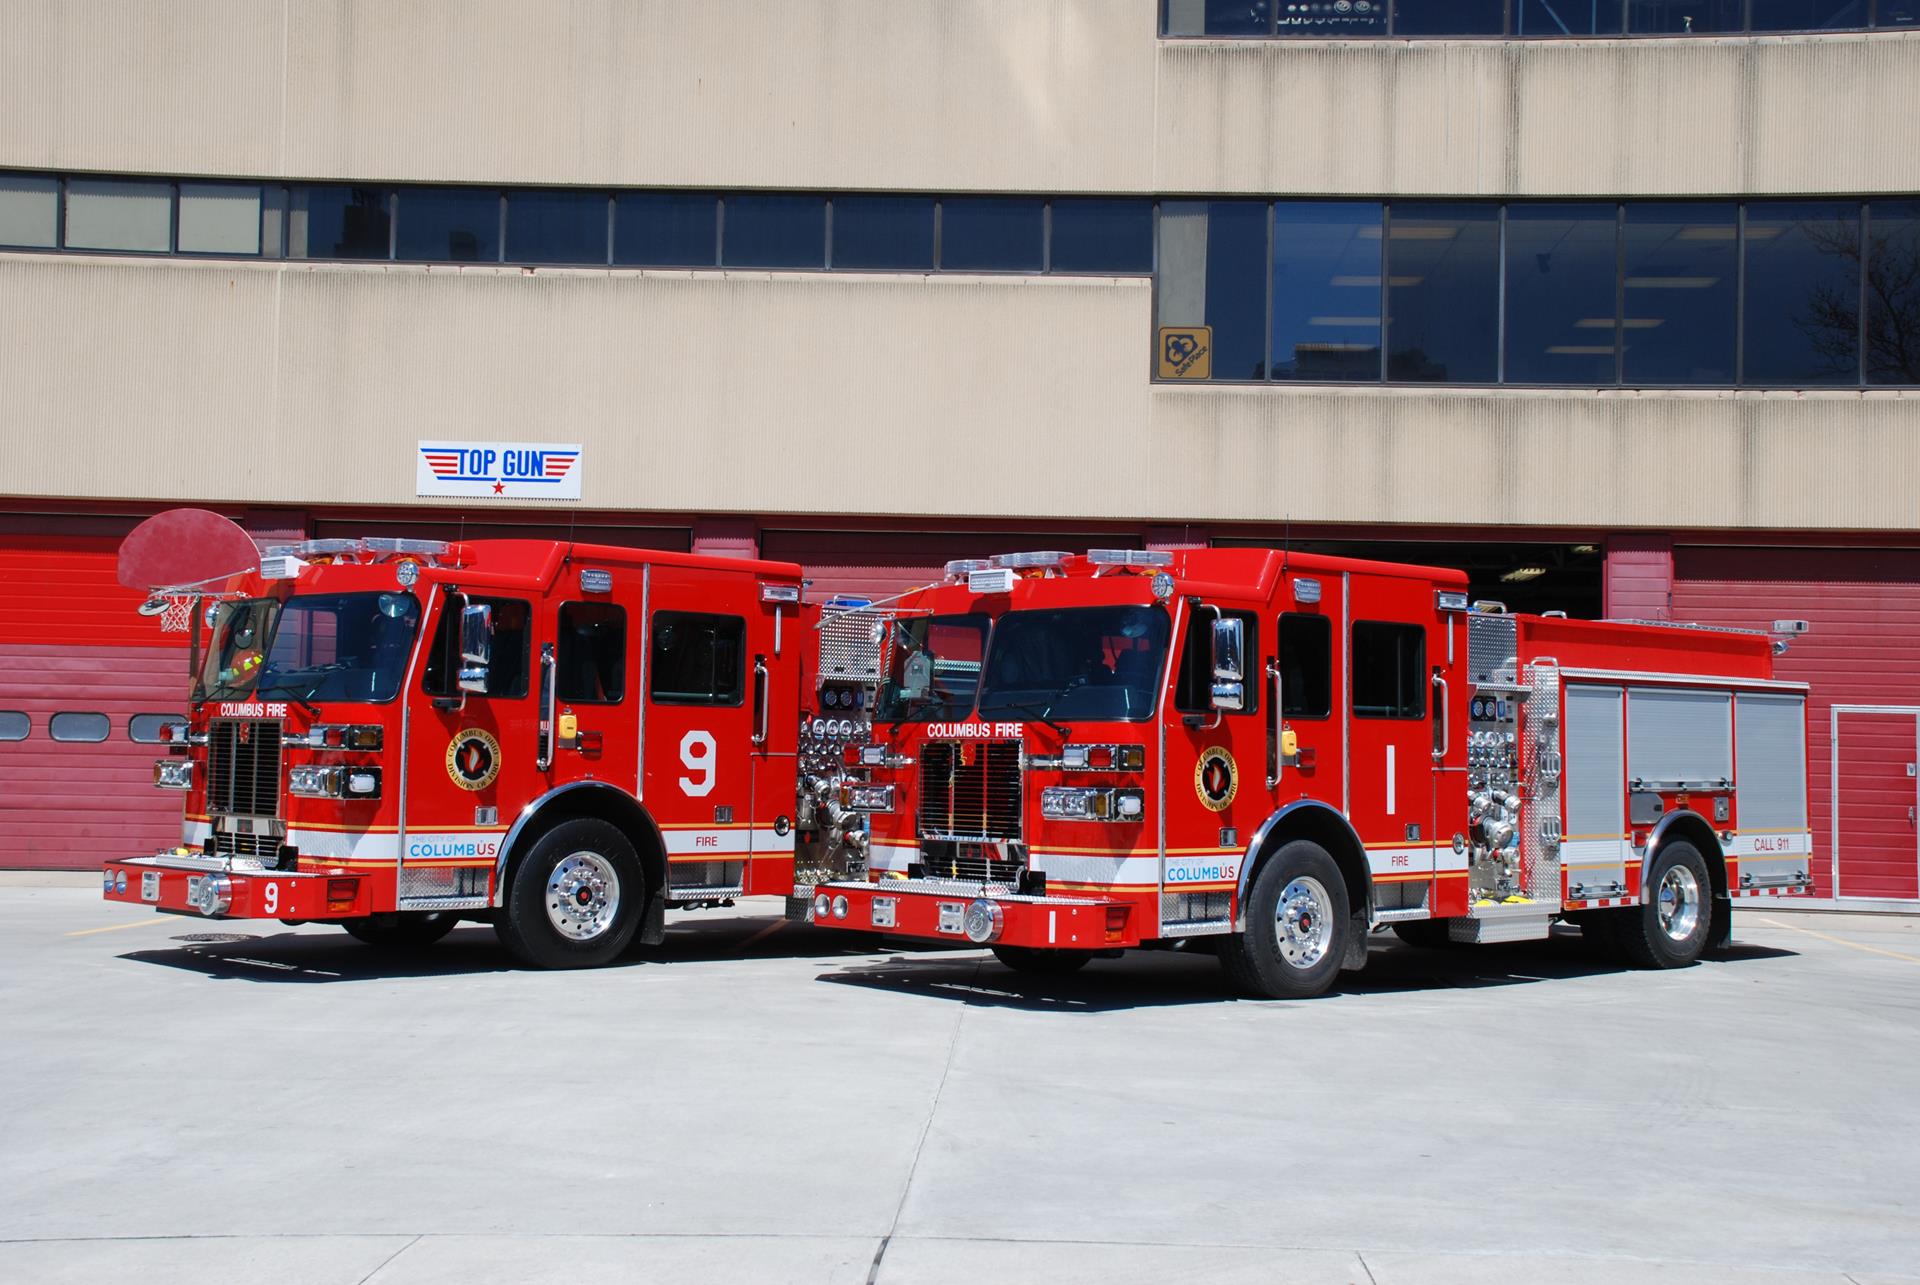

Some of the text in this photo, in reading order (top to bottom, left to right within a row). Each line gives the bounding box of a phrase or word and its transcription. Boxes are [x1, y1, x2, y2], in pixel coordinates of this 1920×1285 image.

[456, 449, 544, 476] TOP GUN
[220, 702, 287, 717] COLUMBUS FIRE
[927, 722, 1024, 737] COLUMBUS FIRE
[679, 730, 717, 797] 9
[695, 836, 718, 847] FIRE
[1754, 837, 1789, 851] CALL 911
[410, 843, 495, 856] COLUMBUS
[1391, 856, 1409, 866] FIRE
[1167, 865, 1235, 881] COLUMBUS
[264, 882, 278, 914] 9
